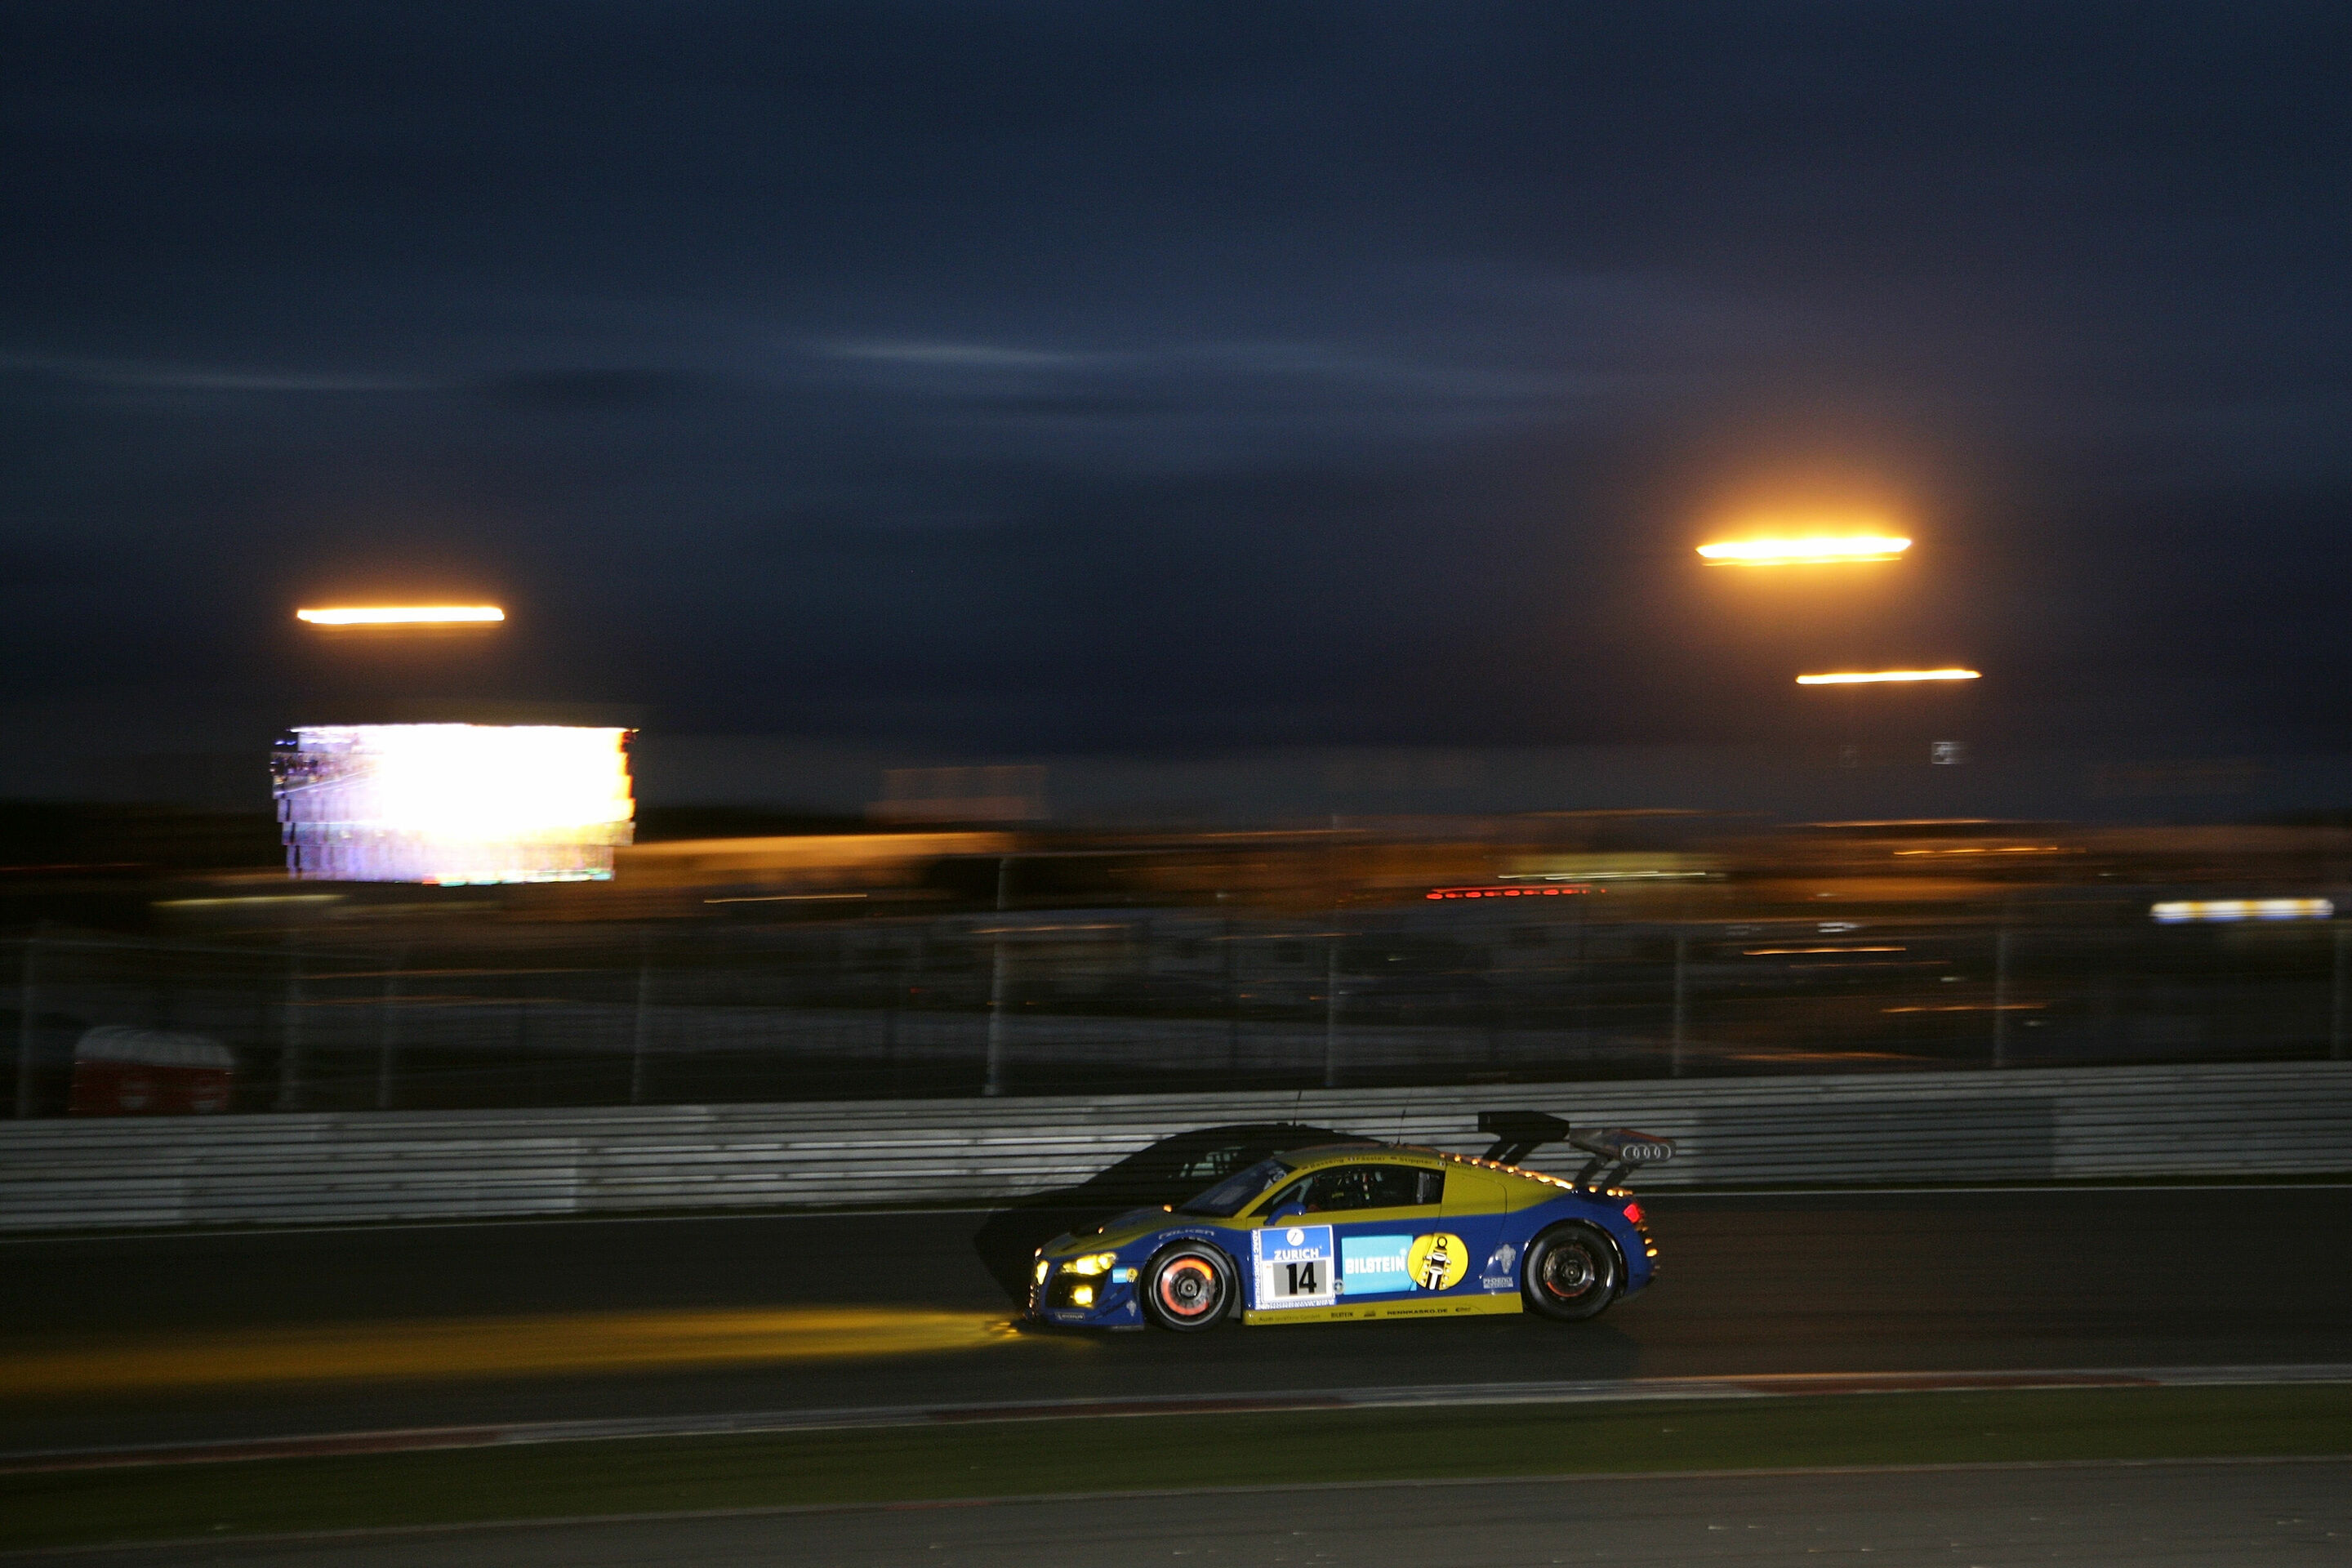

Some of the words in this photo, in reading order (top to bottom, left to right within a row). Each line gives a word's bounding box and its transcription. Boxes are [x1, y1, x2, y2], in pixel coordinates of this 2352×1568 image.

[1274, 1248, 1319, 1260] ZURICH
[1345, 1256, 1405, 1274] BILSTEIN
[1286, 1262, 1317, 1296] 14
